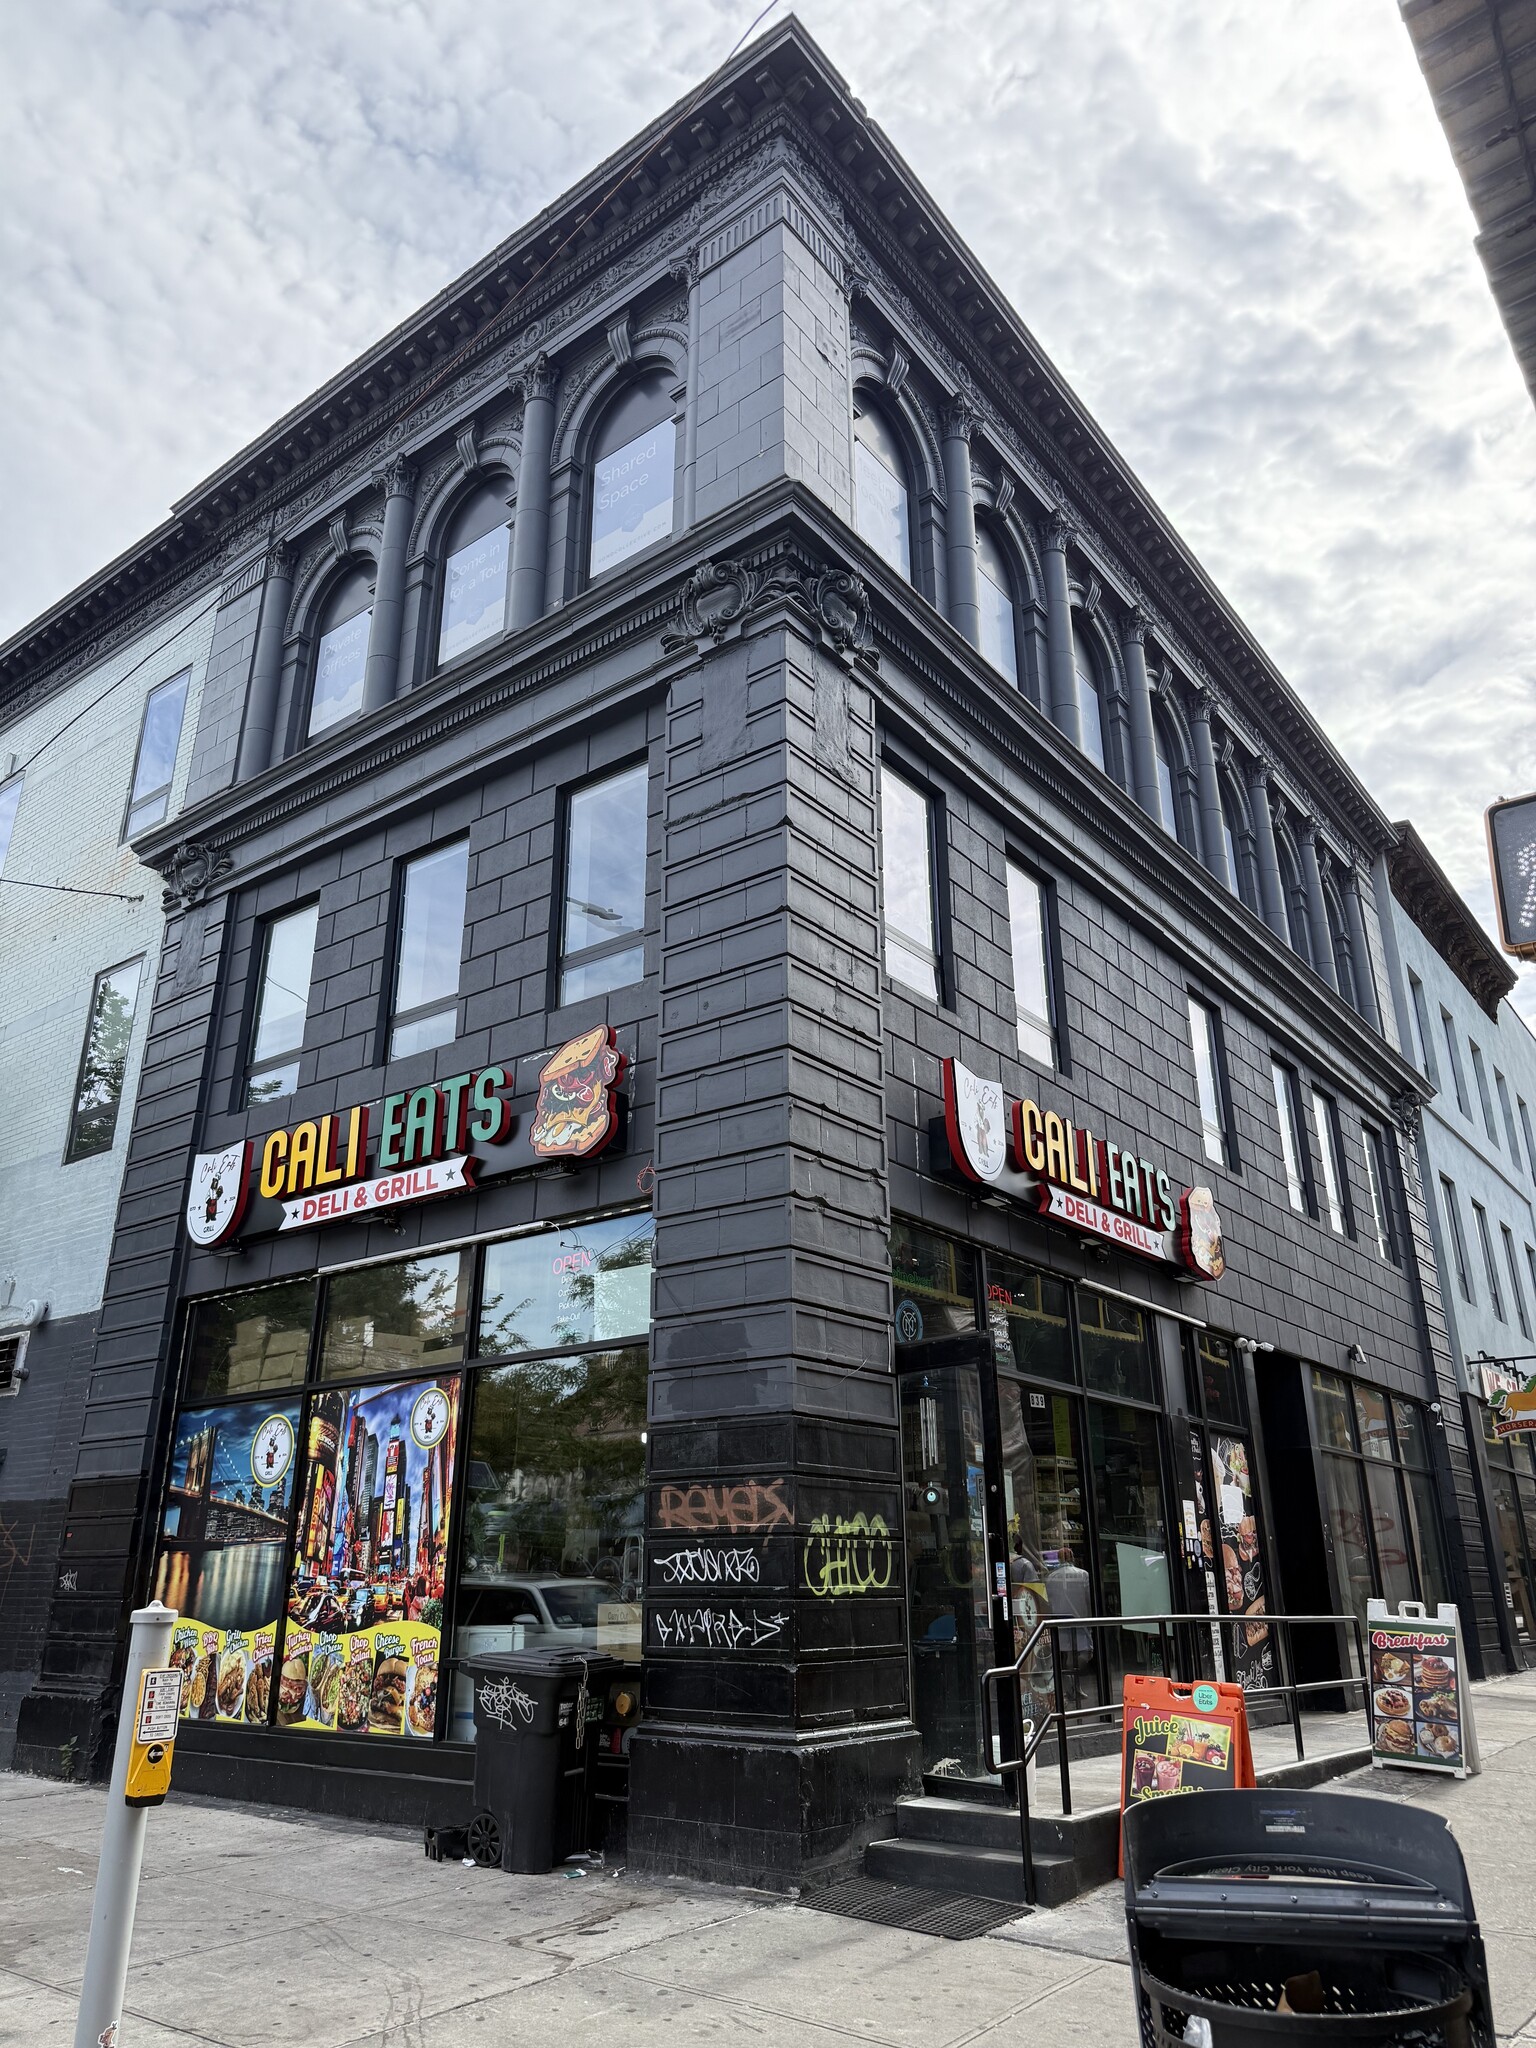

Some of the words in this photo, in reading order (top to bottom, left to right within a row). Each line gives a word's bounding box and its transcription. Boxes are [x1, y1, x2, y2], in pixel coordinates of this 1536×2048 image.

[601, 442, 656, 486] Shared
[600, 473, 648, 510] Space
[452, 553, 486, 580] Come
[490, 544, 500, 557] in
[450, 584, 465, 599] for
[468, 579, 476, 590] a
[480, 560, 506, 582] Tour
[323, 628, 362, 659] Private
[321, 647, 361, 679] Offices
[260, 1106, 361, 1199] CALI
[380, 1066, 506, 1168] EATS
[1022, 1099, 1097, 1196] CALI
[1106, 1140, 1176, 1232] EATS
[302, 1190, 348, 1222] DELI
[353, 1186, 368, 1208] &
[374, 1168, 439, 1203] GRILL
[1065, 1195, 1098, 1228] DELI
[1101, 1212, 1111, 1233] &
[1113, 1217, 1152, 1251] GRILL
[552, 1250, 591, 1274] OPEN
[1500, 1420, 1536, 1433] HORSER
[174, 1626, 198, 1644] Chicken
[226, 1629, 242, 1645] Grill
[255, 1632, 274, 1647] Fried
[286, 1630, 311, 1649] Turkey
[319, 1631, 338, 1646] Chop
[350, 1635, 368, 1651] Chop
[375, 1632, 400, 1650] Cheese
[1372, 1630, 1449, 1651] Breakfast
[253, 1645, 274, 1661] Chicken
[384, 1644, 405, 1658] Burger
[411, 1637, 438, 1653] French
[351, 1650, 371, 1666] Salad
[416, 1652, 434, 1667] Toast
[1134, 1716, 1178, 1745] Juice
[1244, 1864, 1270, 1873] City
[1274, 1865, 1304, 1874] York
[1308, 1867, 1337, 1876] New
[1341, 1869, 1376, 1882] Keep
